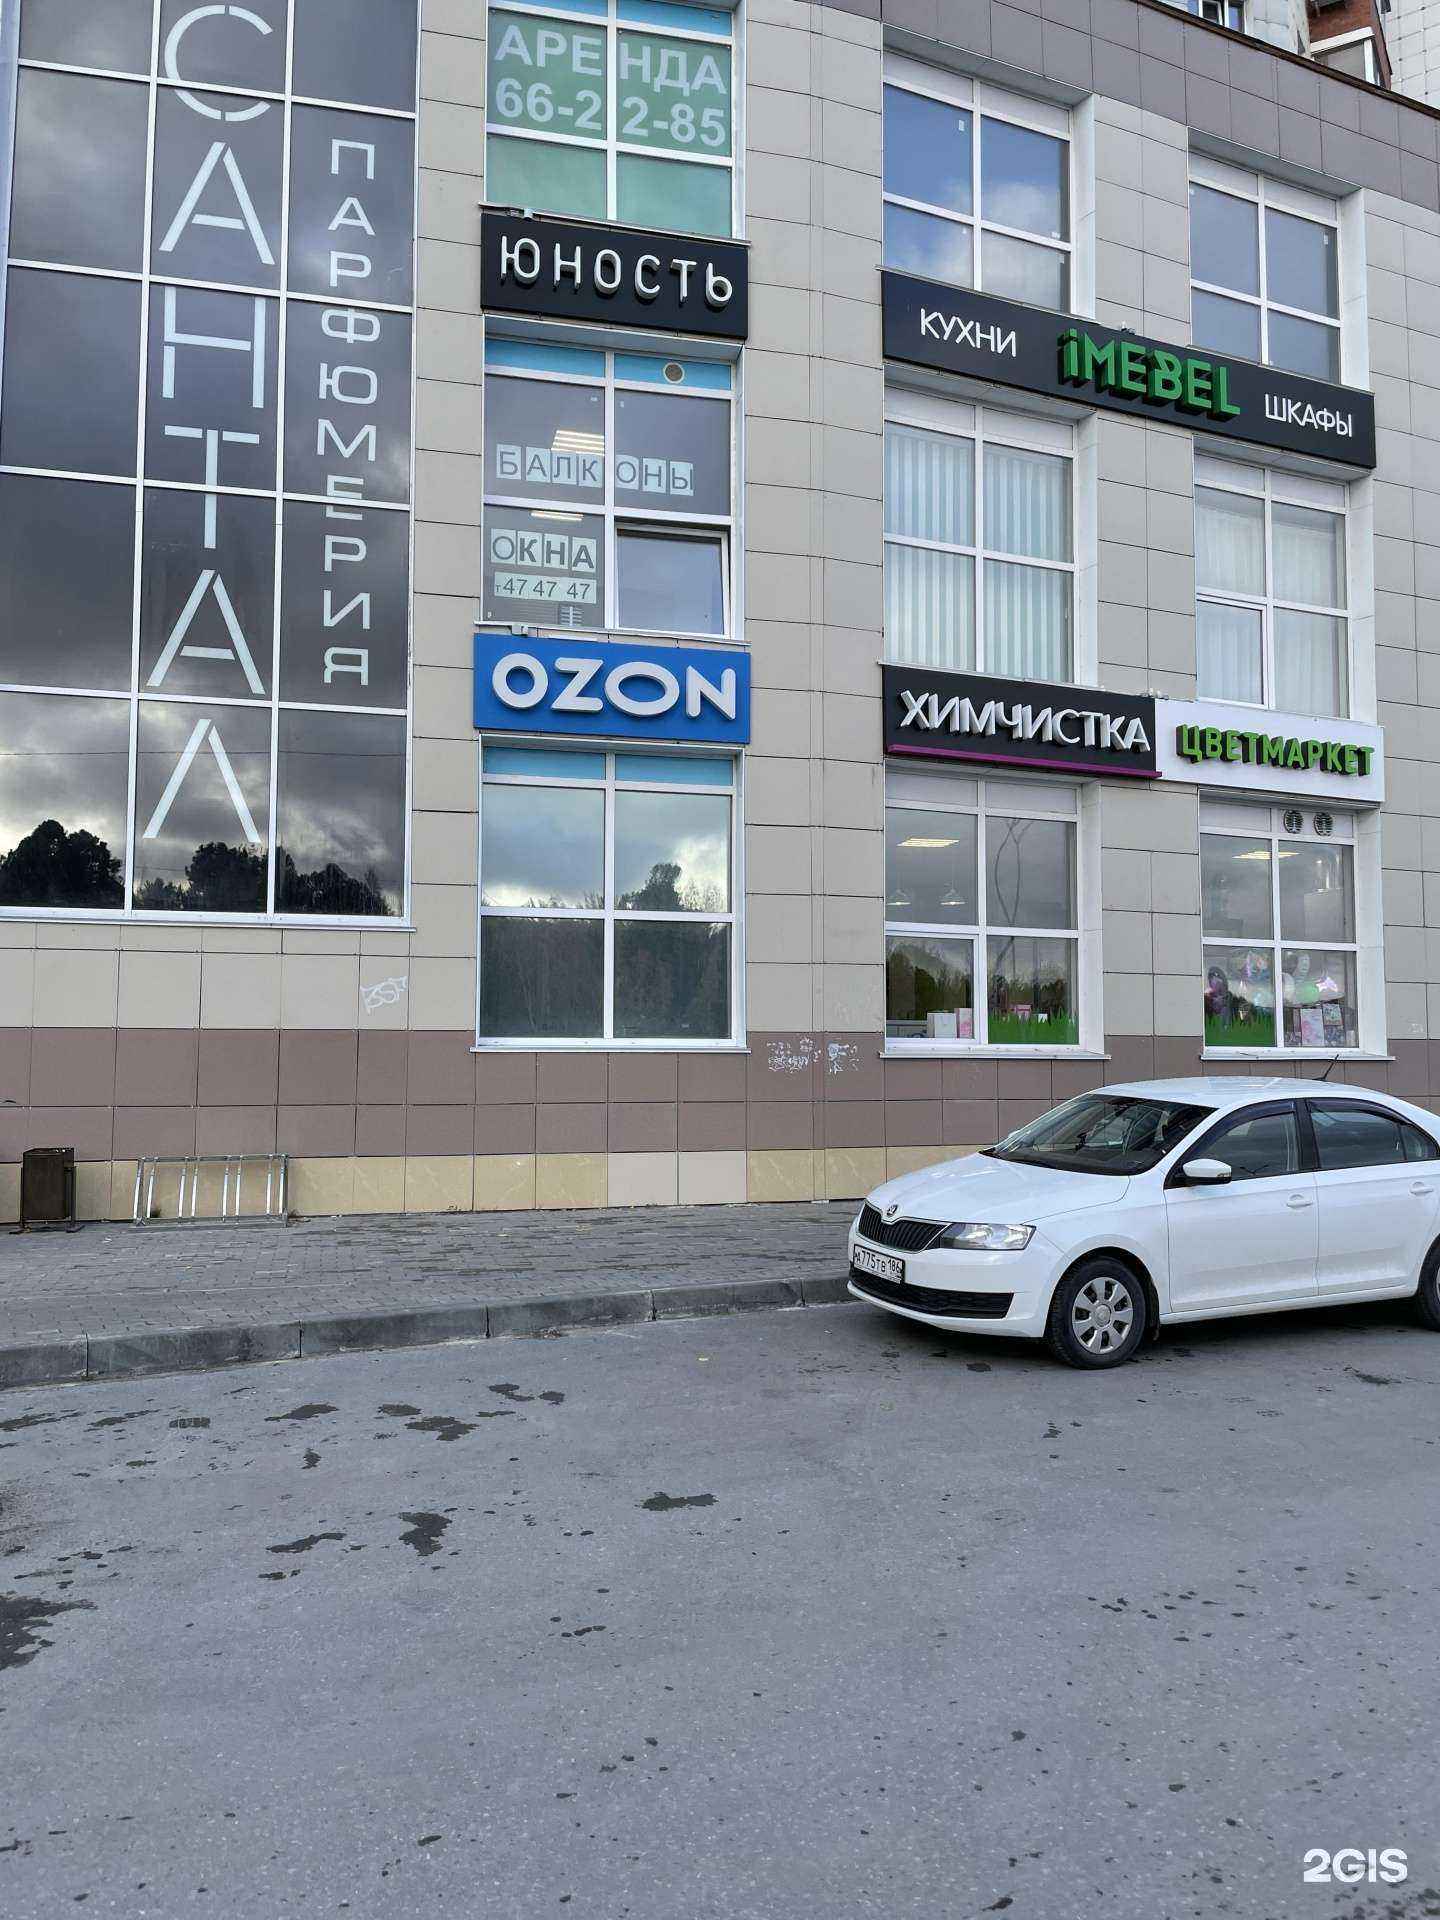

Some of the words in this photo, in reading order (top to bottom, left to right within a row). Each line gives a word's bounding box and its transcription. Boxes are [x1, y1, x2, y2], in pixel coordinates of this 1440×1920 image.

[494, 24, 727, 97] АРЕНДА
[495, 77, 726, 147] 66-22-85
[500, 235, 733, 307] ЮНОСТЬ
[919, 308, 1018, 358] КУХНИ
[142, 4, 275, 844] САНТАЛ
[317, 138, 381, 686] ПАРФЮМЕРИЯ
[1264, 393, 1354, 438] ШКАФЫ
[499, 451, 693, 491] БАЛКОНЫ
[492, 535, 595, 569] ОКНА
[532, 580, 557, 597] 47
[566, 583, 591, 599] 47
[492, 653, 736, 721] OZON
[900, 689, 1152, 753] ХИМЧИСТКА
[1176, 724, 1375, 776] ЦВЕТМАРКЕТ
